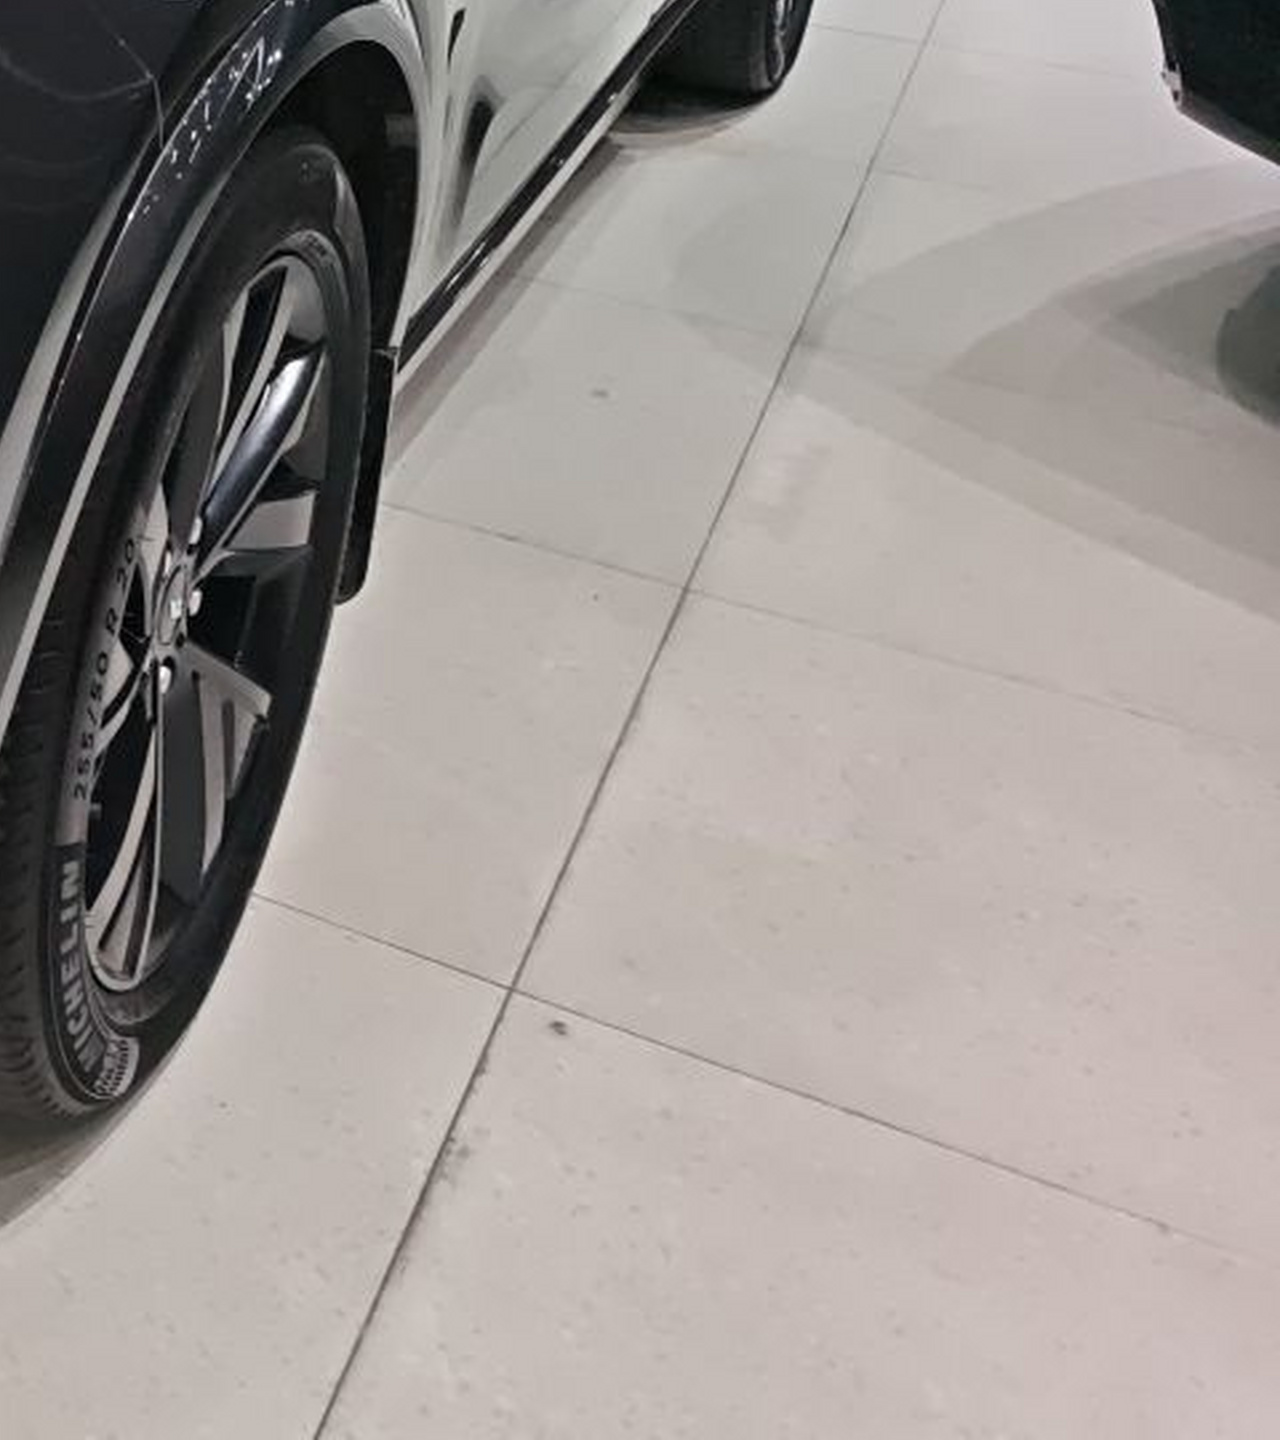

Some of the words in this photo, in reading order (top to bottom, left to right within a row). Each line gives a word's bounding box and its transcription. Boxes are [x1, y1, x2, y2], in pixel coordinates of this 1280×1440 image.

[73, 651, 109, 801] 255/50
[105, 607, 119, 637] R
[116, 537, 136, 592] 20
[59, 860, 106, 1074] MICHELIN
